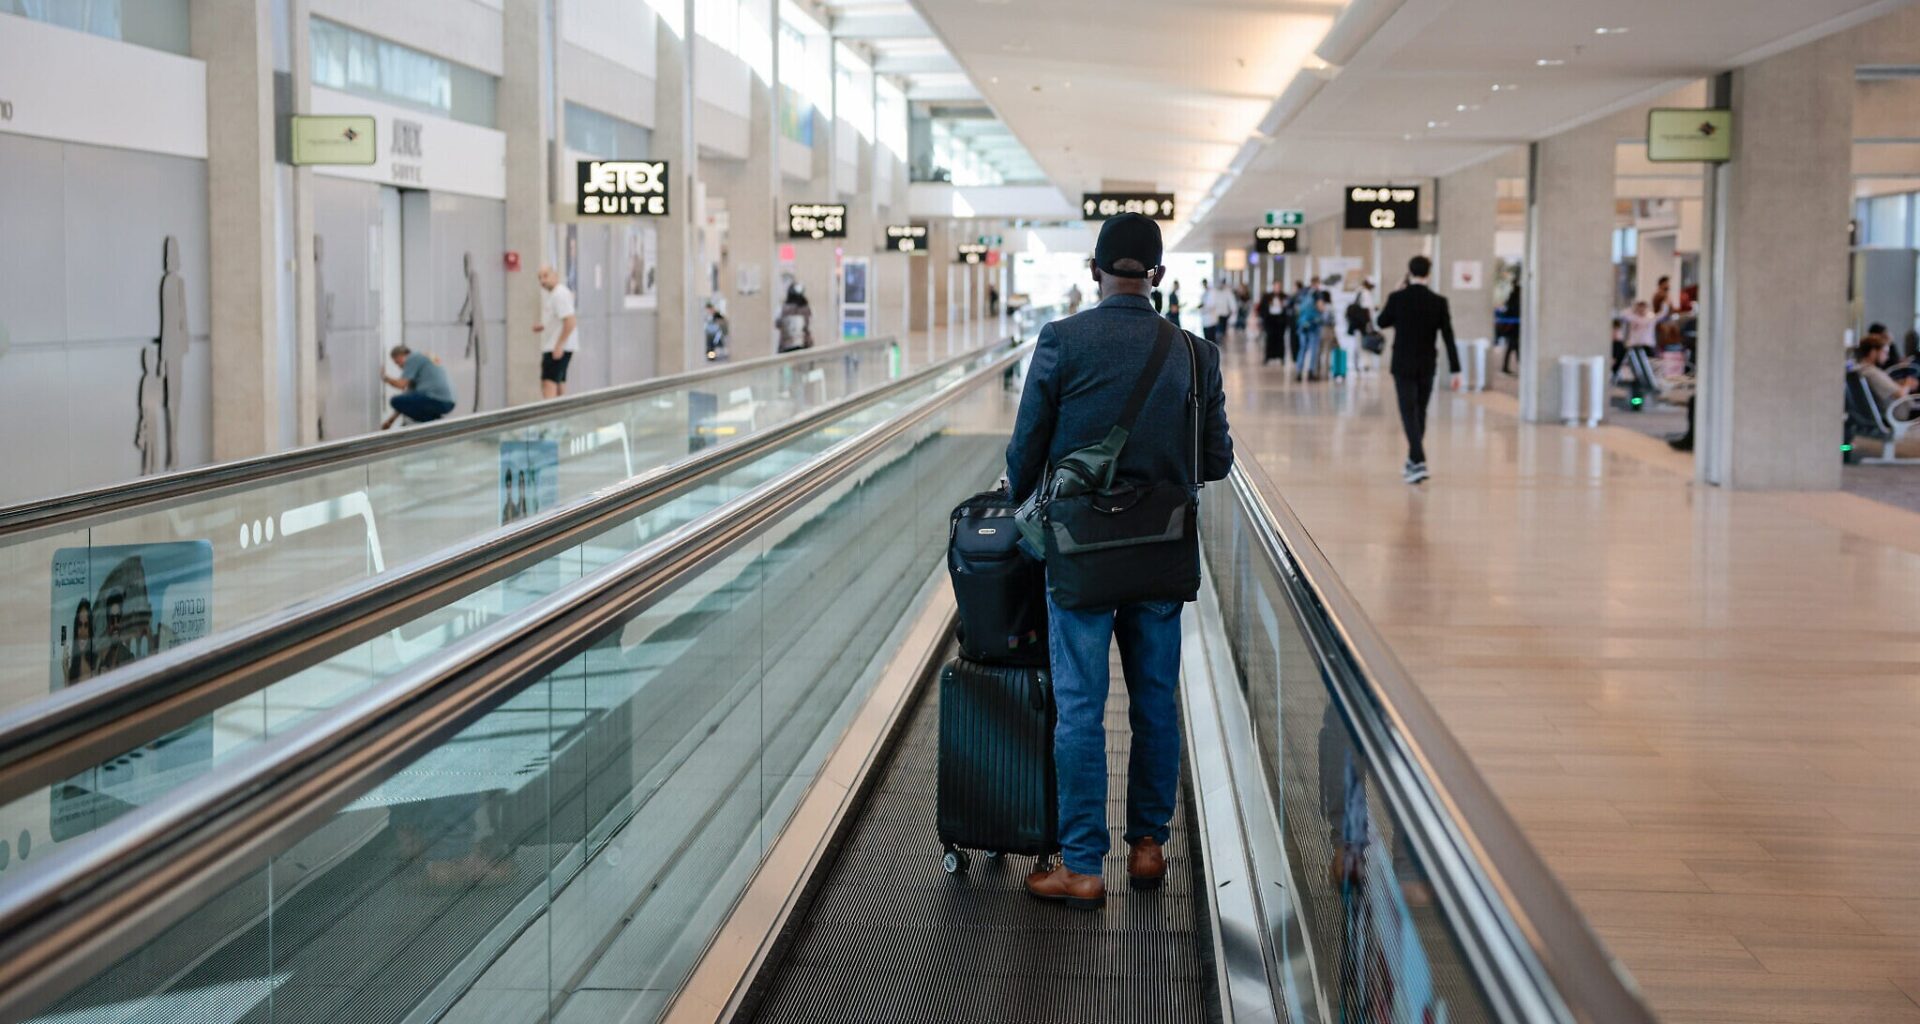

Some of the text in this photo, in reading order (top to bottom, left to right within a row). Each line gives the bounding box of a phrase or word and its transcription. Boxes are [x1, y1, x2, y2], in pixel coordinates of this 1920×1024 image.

[584, 161, 664, 193] JETEX
[584, 196, 664, 214] SUITE
[1369, 208, 1396, 229] C2
[55, 562, 67, 577] FLY
